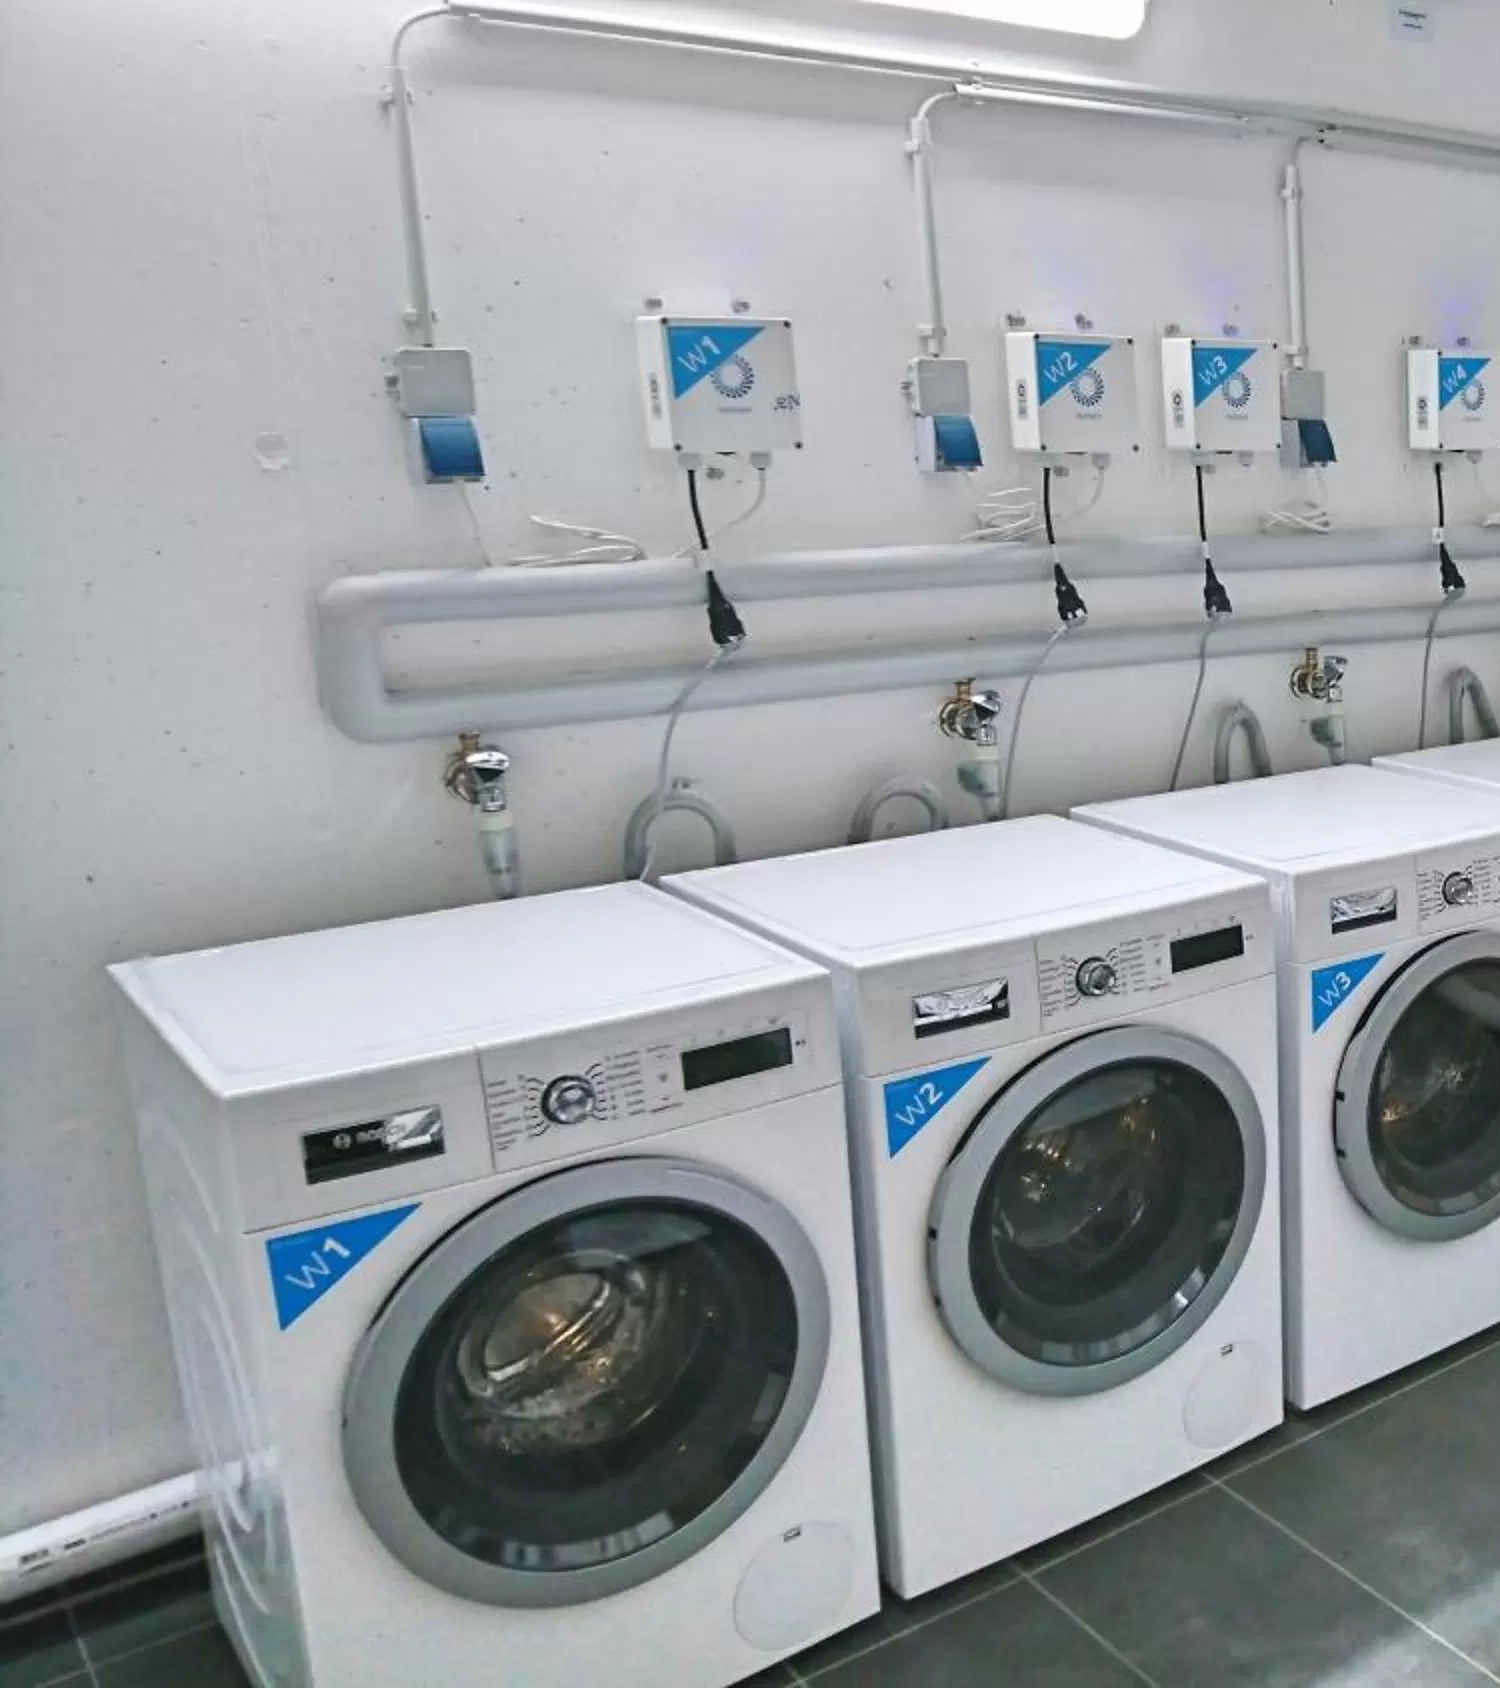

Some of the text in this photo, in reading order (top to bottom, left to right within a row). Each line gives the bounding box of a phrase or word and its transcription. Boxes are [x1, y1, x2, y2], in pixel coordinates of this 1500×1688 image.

[676, 335, 721, 373] W1
[1043, 351, 1078, 384] W2
[1198, 355, 1228, 385] W3
[1442, 363, 1468, 394] W4
[1317, 971, 1352, 1007] W3
[895, 1082, 944, 1127] W2
[284, 1236, 351, 1289] W1
